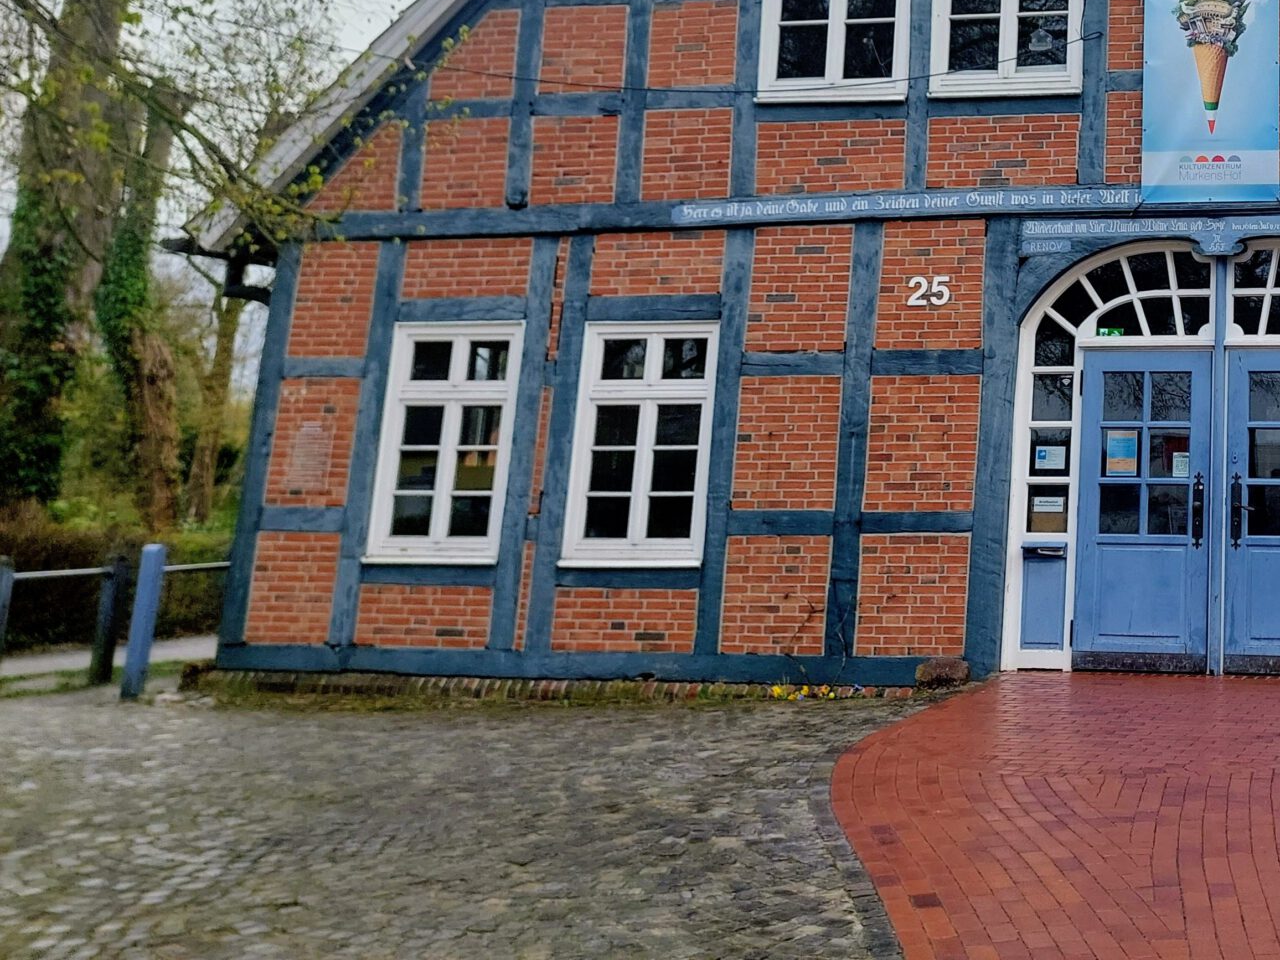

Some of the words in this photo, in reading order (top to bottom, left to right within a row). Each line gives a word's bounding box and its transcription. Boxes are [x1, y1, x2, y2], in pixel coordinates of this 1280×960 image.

[756, 201, 785, 216] deine
[786, 199, 819, 214] Gabe
[825, 198, 847, 212] und
[852, 196, 869, 211] ein
[874, 194, 920, 211] Zeichen
[924, 193, 960, 209] deiner
[966, 190, 1004, 208] Gunst
[1011, 193, 1036, 206] was
[1042, 191, 1054, 205] in
[1060, 190, 1092, 206] dieser
[1099, 189, 1130, 204] Welt
[1030, 241, 1063, 252] RENOV
[906, 275, 950, 306] 25
